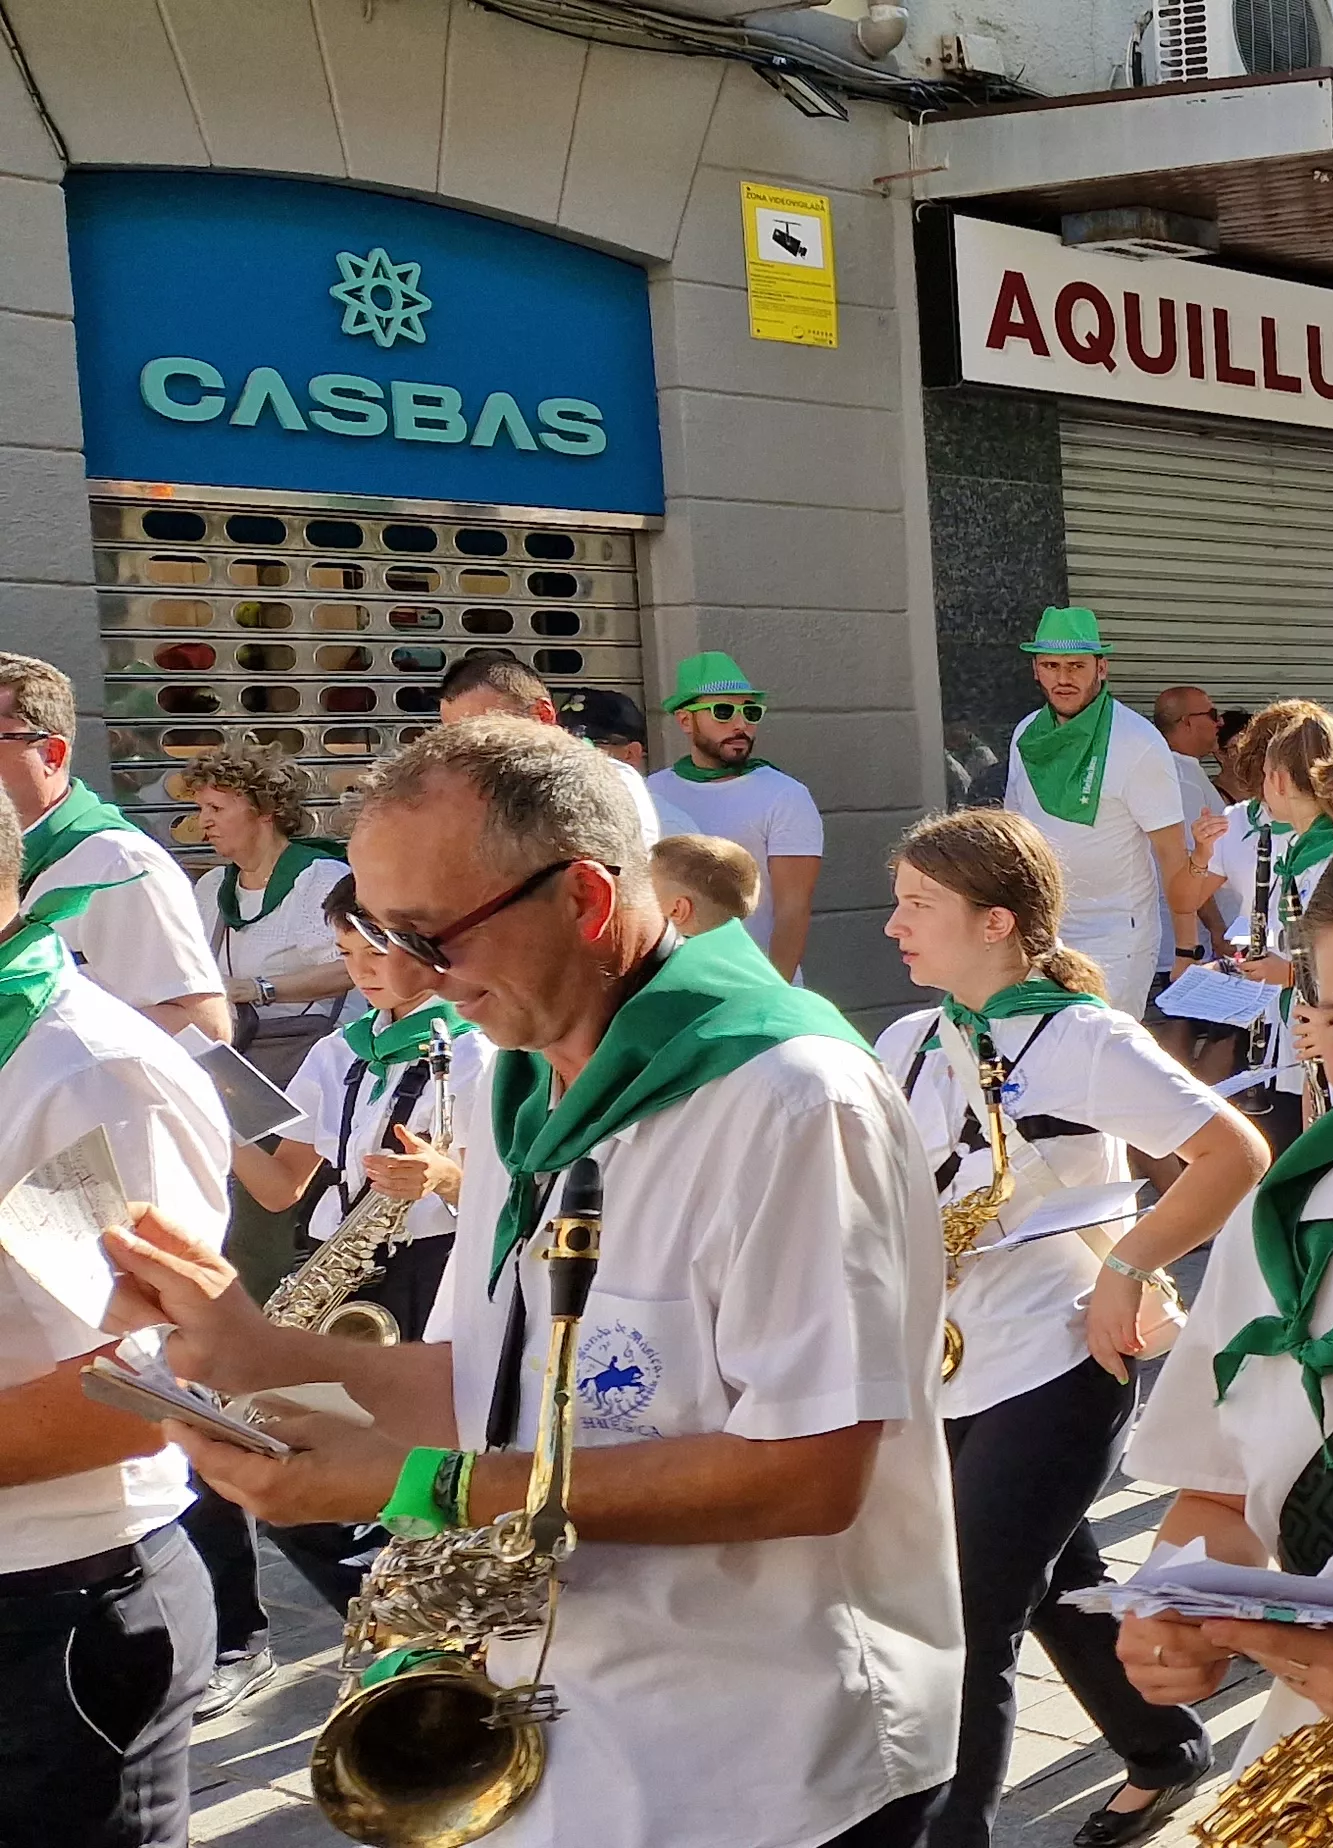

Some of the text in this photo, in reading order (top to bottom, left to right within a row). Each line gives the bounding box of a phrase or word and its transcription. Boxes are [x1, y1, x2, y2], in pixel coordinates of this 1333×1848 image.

[746, 191, 826, 212] ZONA VIDEOVIGILADA
[139, 356, 608, 456] CASBAS
